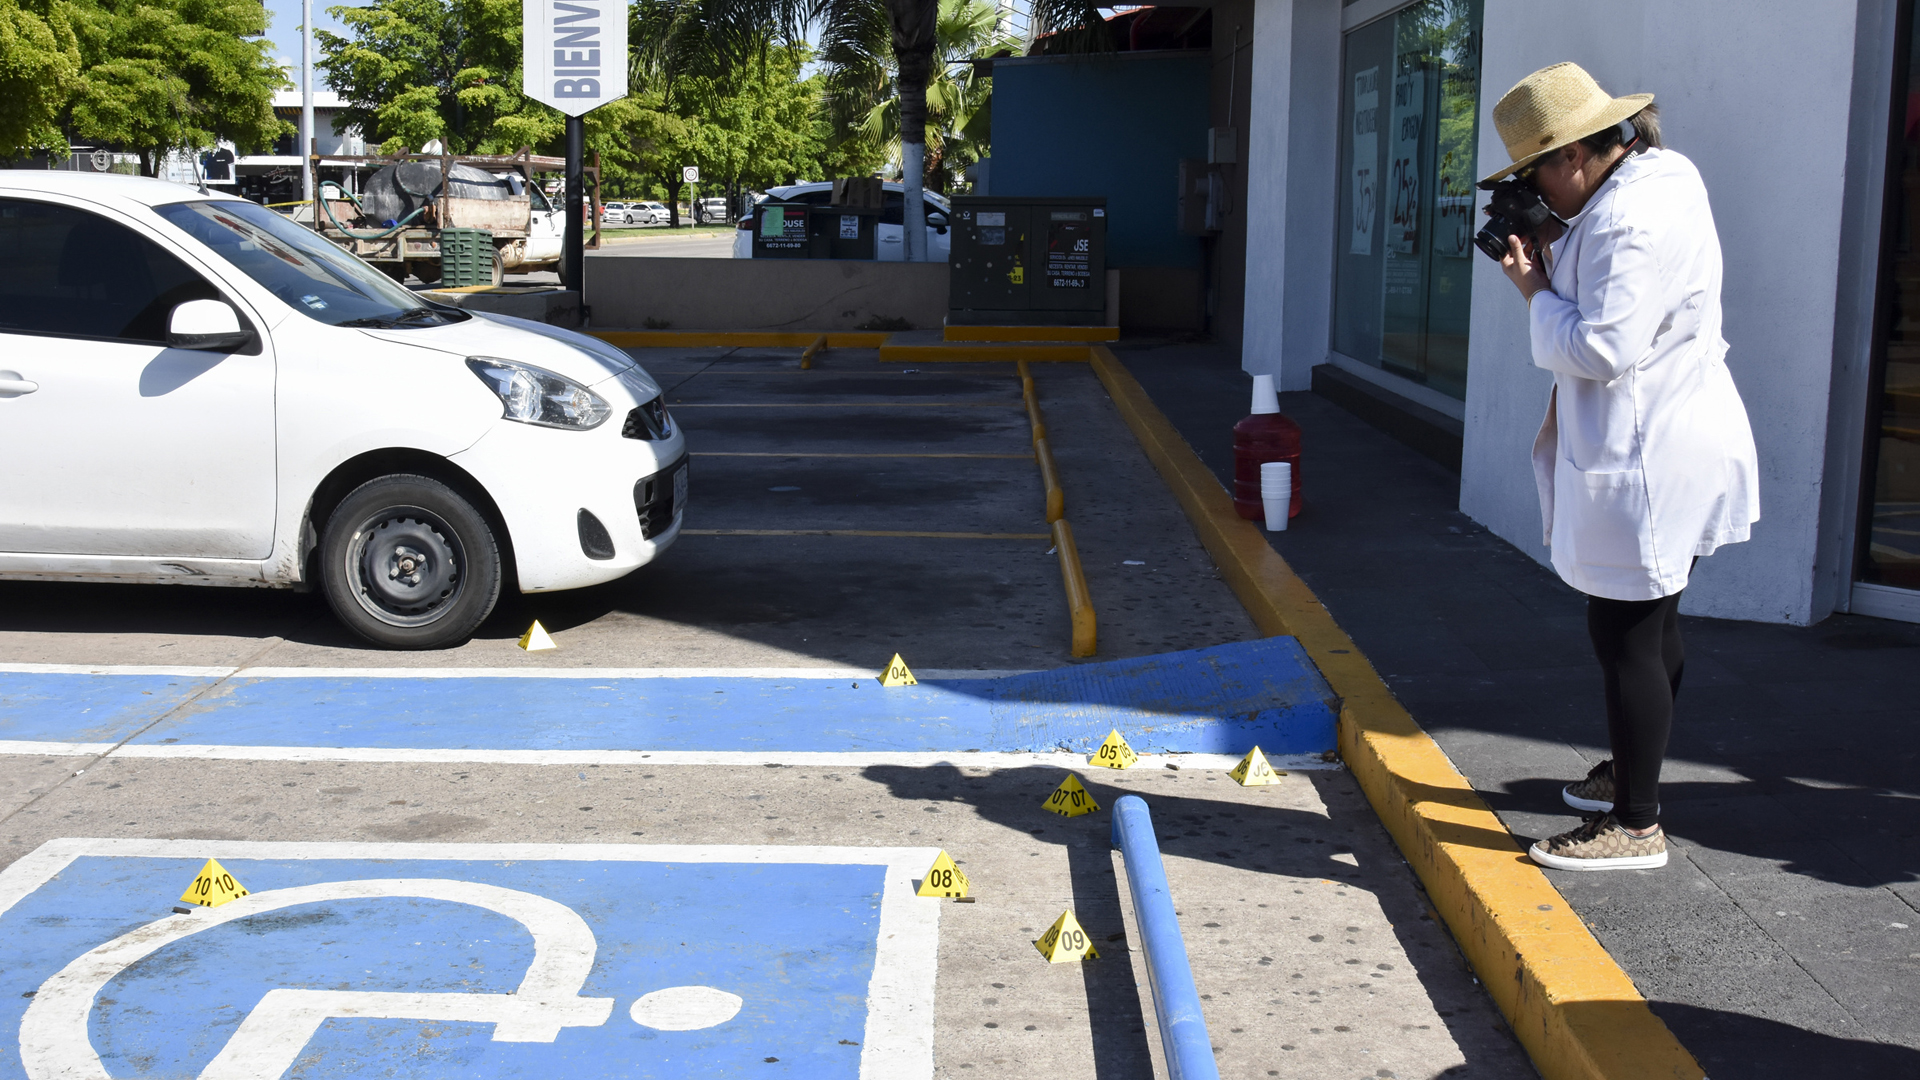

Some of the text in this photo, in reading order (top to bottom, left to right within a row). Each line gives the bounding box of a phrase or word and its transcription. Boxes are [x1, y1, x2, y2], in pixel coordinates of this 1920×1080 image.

[553, 0, 601, 99] BIENV
[1393, 157, 1417, 227] 25%
[783, 219, 805, 228] OUSE
[891, 665, 908, 680] 04
[1100, 742, 1132, 760] 05 05
[1237, 758, 1250, 775] 06
[1052, 788, 1086, 807] 07 07
[194, 873, 235, 897] 10 10
[930, 868, 953, 889] 08
[1044, 925, 1085, 952] 09 09
